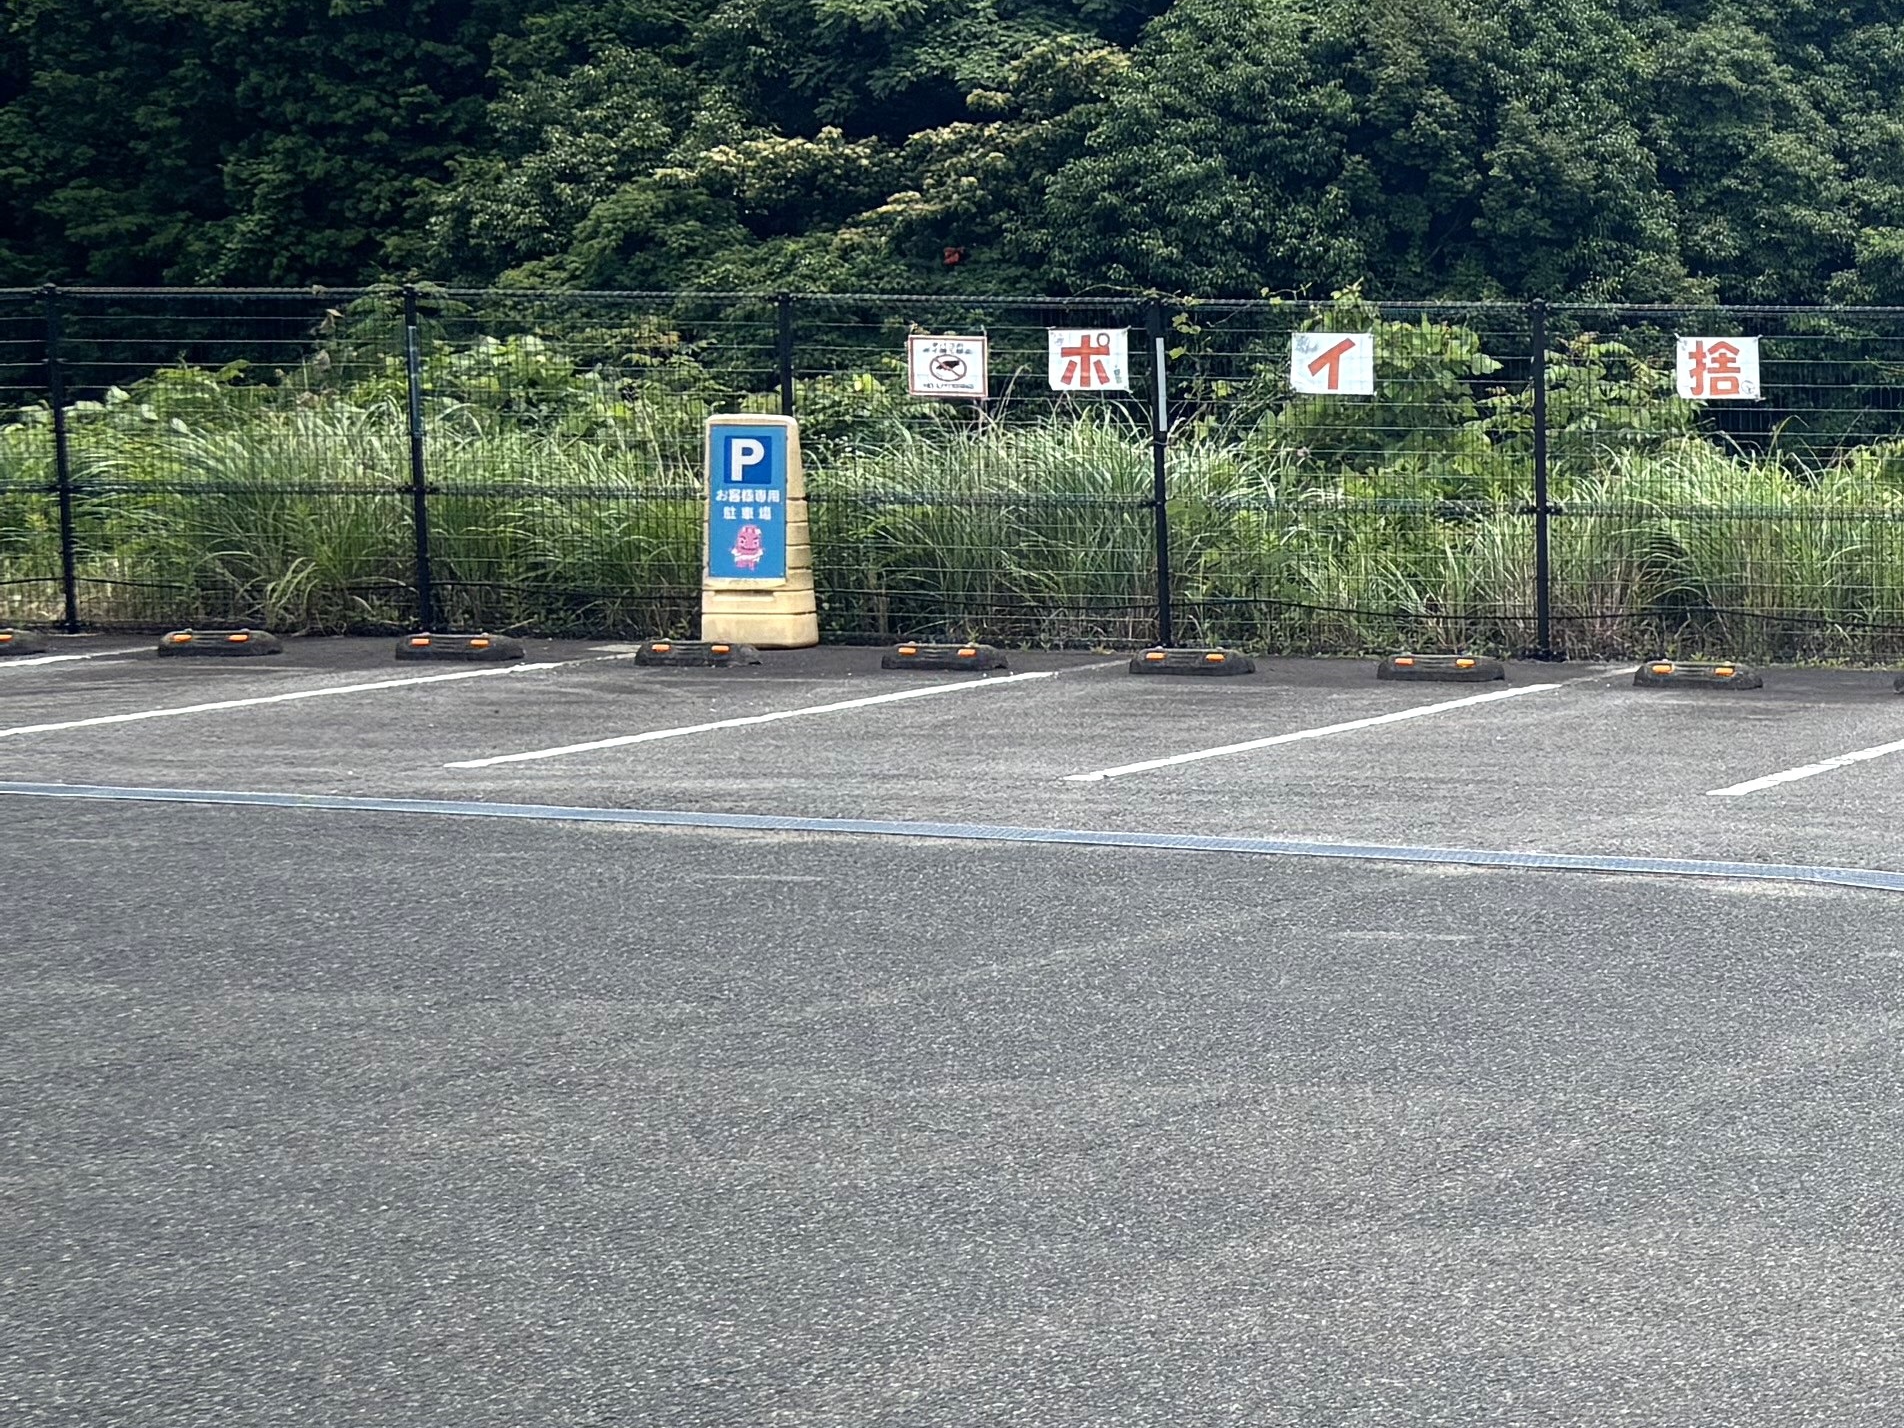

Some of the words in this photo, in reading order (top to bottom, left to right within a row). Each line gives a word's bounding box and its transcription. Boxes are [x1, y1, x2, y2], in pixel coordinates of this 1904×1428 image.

[1060, 332, 1111, 387] ポ
[1307, 337, 1356, 390] イ
[1688, 339, 1741, 396] 捨
[730, 437, 765, 482] P
[715, 488, 781, 504] お客様専用
[722, 505, 772, 521] 駐車場
